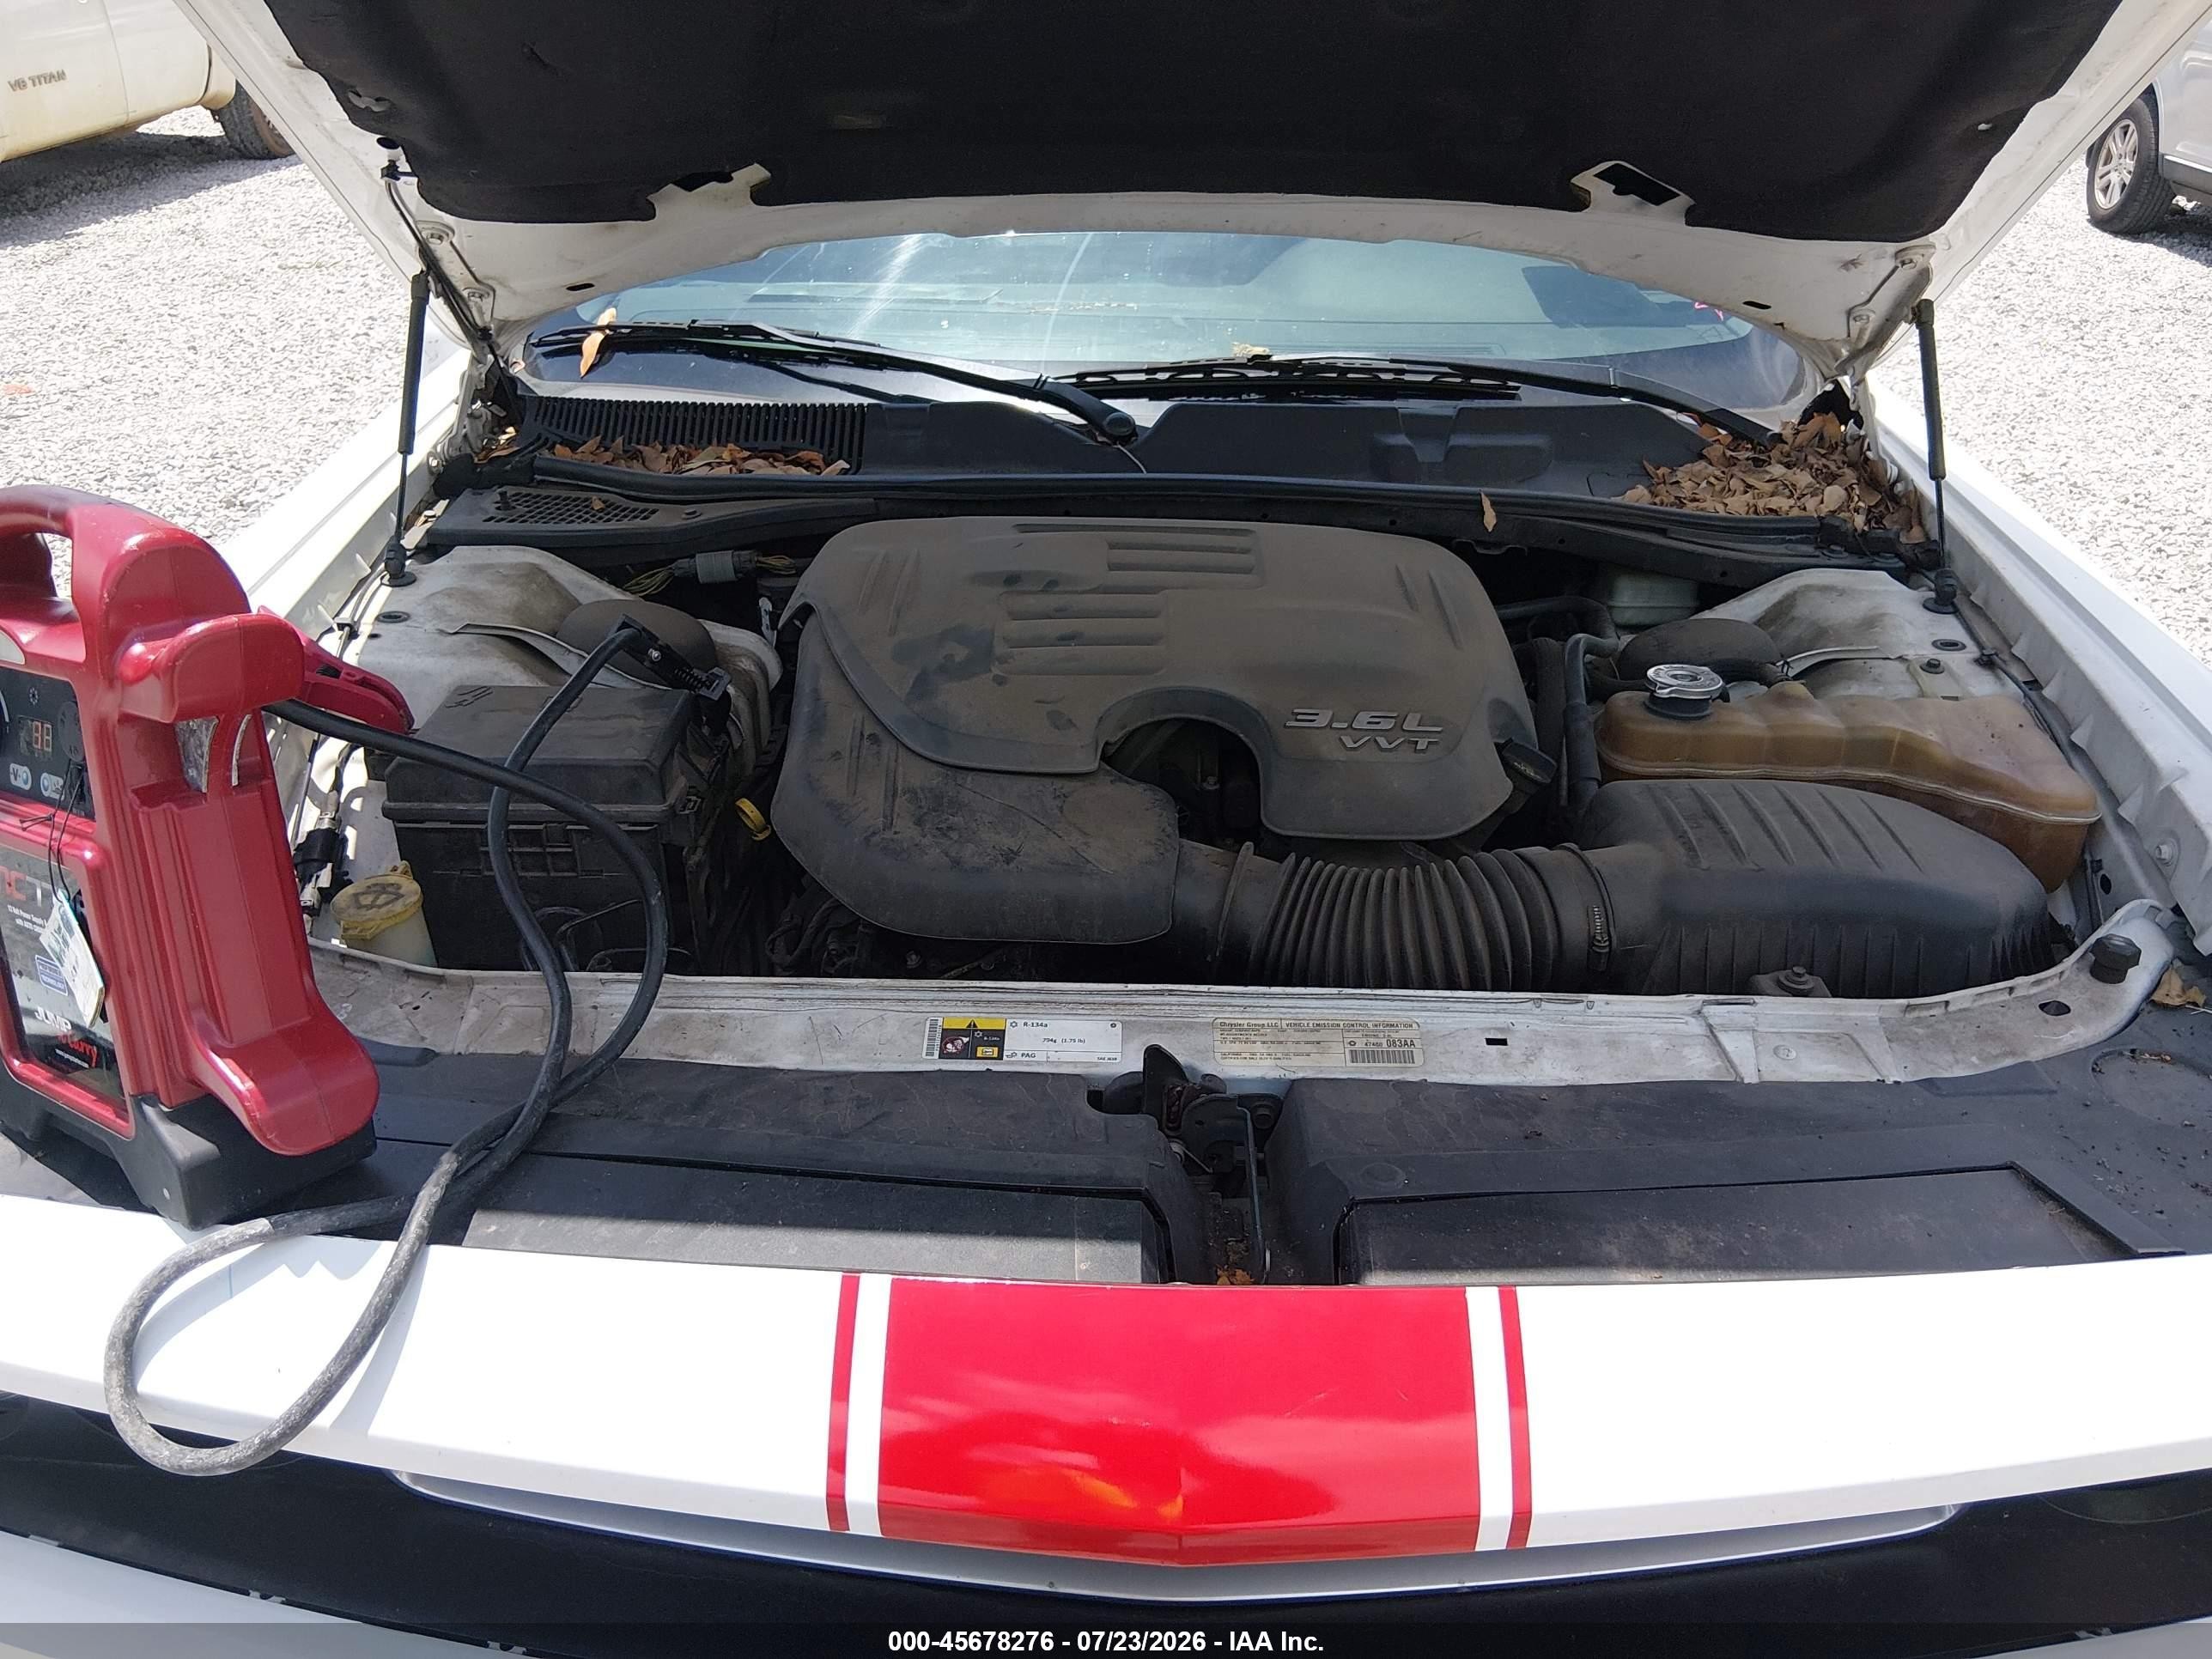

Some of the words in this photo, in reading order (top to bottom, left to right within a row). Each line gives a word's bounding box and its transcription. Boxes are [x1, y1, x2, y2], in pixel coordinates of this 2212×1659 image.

[28, 69, 67, 88] TITAN
[1285, 708, 1443, 732] 3.6L
[1340, 735, 1440, 750] VVT
[34, 1006, 72, 1032] JUMP
[1386, 1039, 1416, 1048] 083AA
